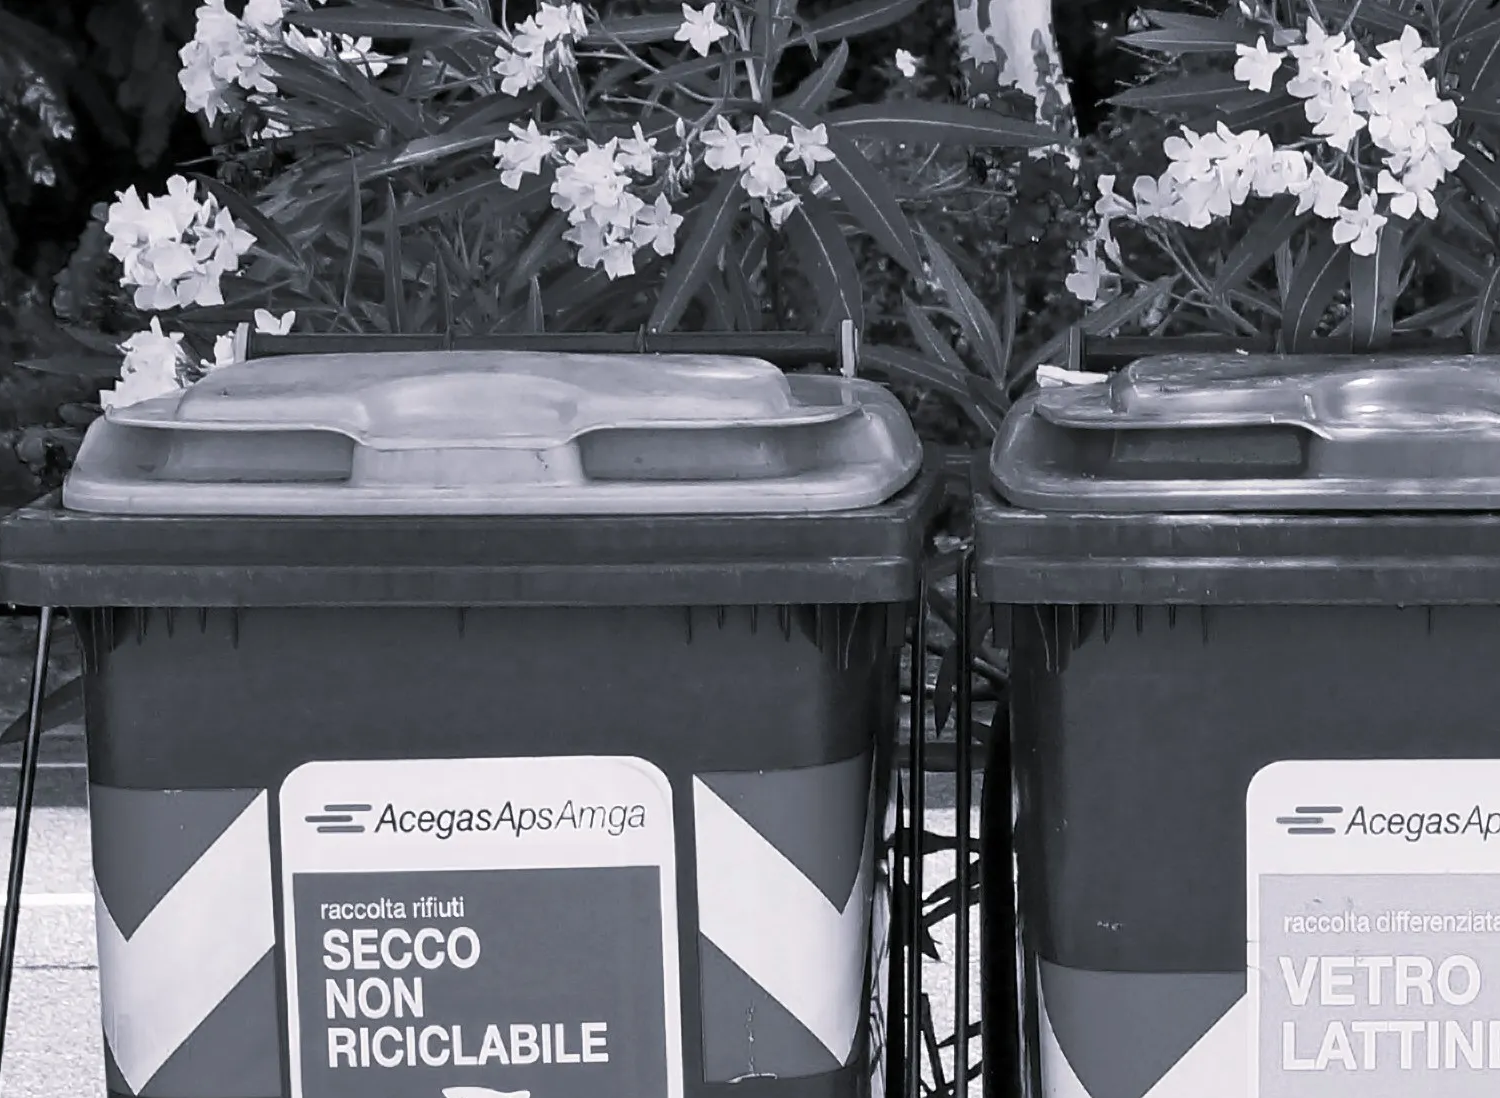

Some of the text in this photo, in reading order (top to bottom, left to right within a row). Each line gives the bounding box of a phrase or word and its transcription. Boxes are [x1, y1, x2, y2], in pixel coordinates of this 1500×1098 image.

[373, 800, 645, 839] AcegasApsAmga
[320, 896, 465, 919] raccolta rifiuti
[1283, 911, 1370, 933] raccolta
[322, 926, 481, 971] SECCO
[325, 977, 424, 1019] NON
[1278, 954, 1482, 1007] VETRO
[328, 1021, 609, 1068] RICICLABILE
